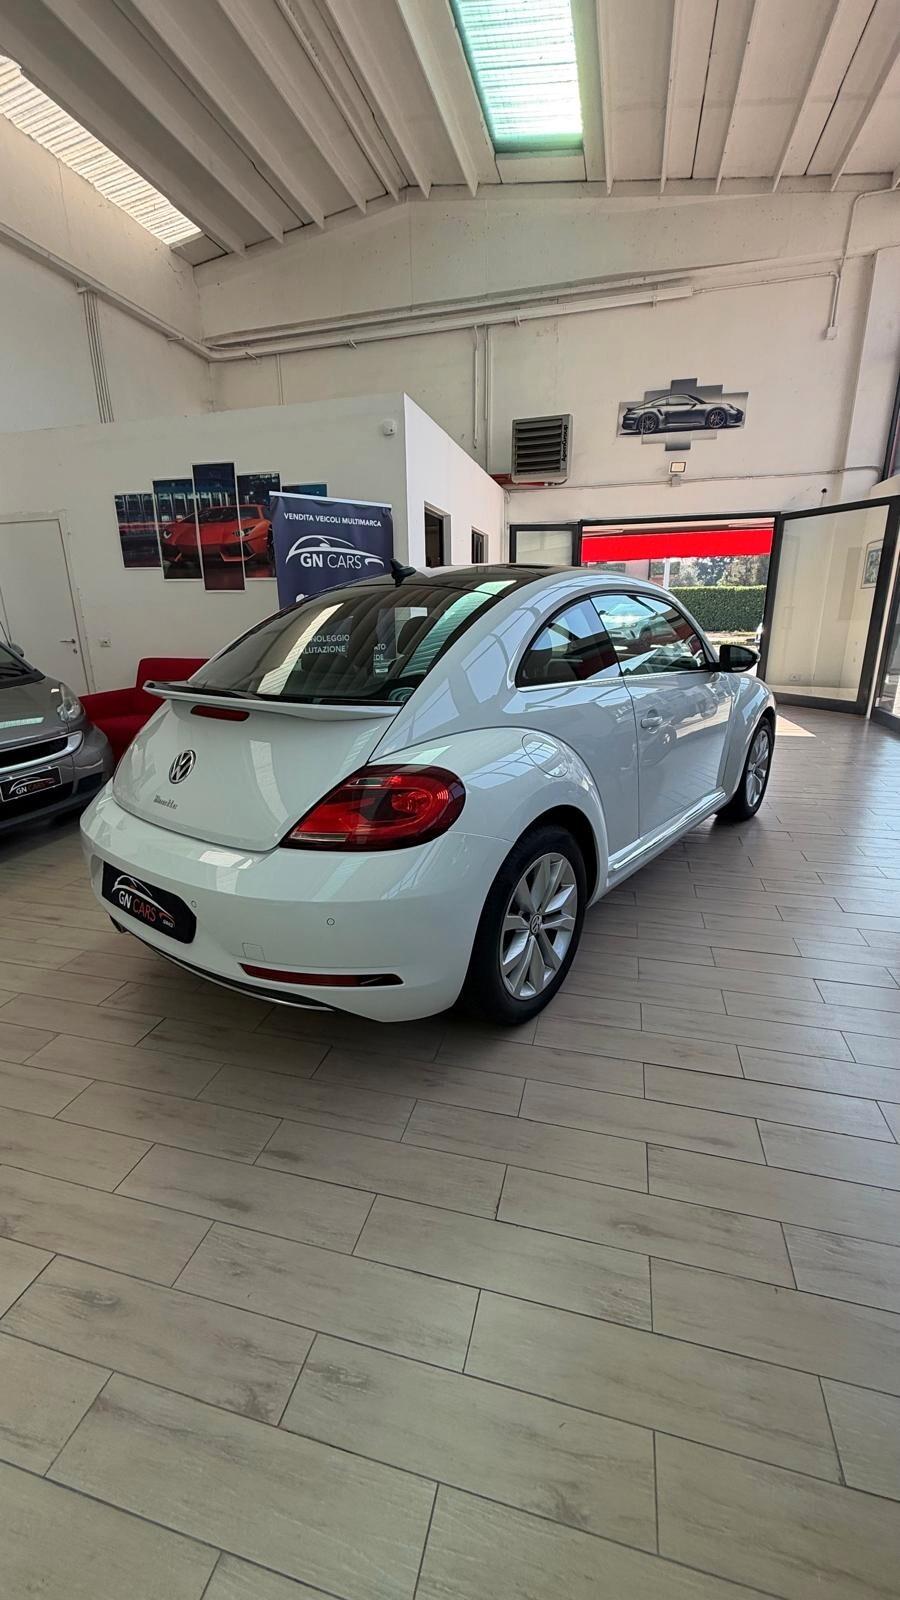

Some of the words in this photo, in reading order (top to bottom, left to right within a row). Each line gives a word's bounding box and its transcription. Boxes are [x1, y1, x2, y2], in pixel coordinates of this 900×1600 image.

[284, 512, 314, 522] VENDITA
[315, 515, 341, 524] VEICOLI
[342, 517, 382, 528] MULTIMARCA
[300, 553, 324, 568] GN
[327, 554, 362, 569] CARS
[302, 645, 346, 655] LUTAZIONE
[15, 786, 28, 795] GN
[118, 890, 132, 909] GN
[133, 898, 157, 922] CARS
